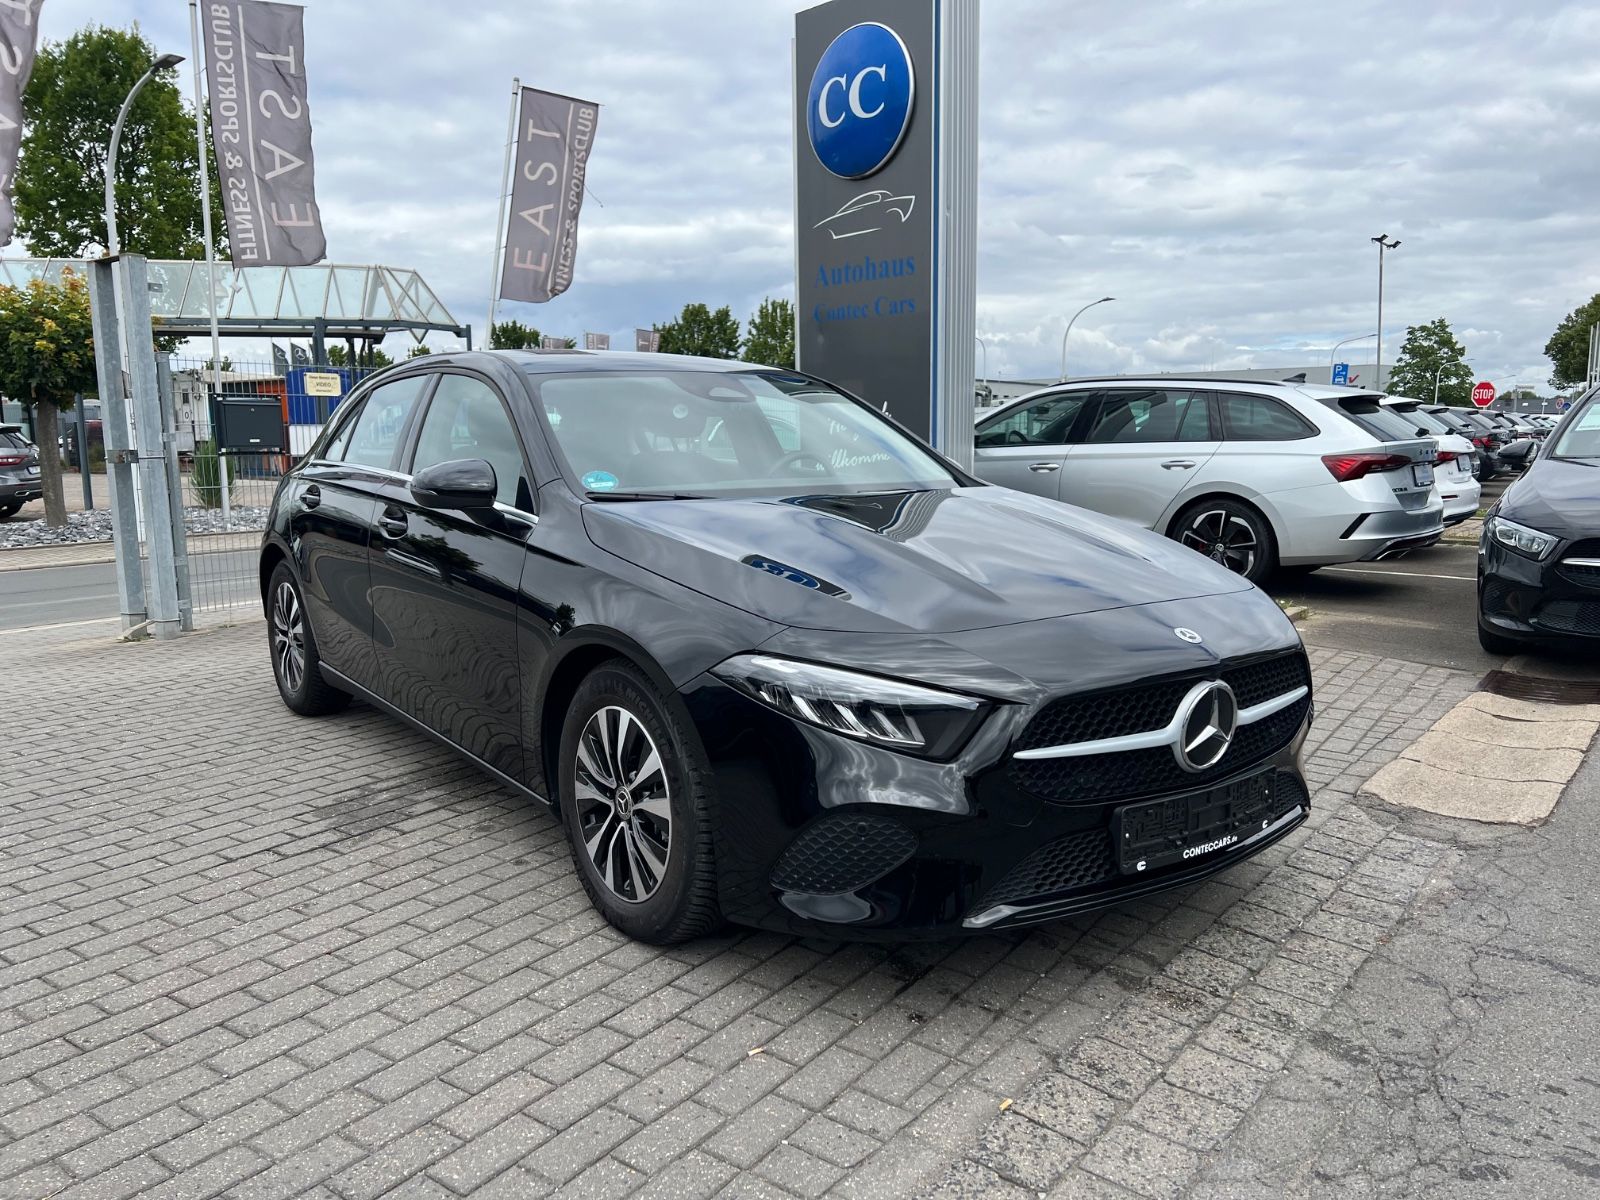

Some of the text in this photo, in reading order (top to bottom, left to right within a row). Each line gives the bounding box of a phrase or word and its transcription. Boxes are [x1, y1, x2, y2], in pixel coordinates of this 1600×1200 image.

[818, 64, 887, 128] CC
[569, 107, 595, 213] SPORTSCLUB
[513, 118, 561, 273] EAST
[565, 219, 576, 232] &
[815, 255, 916, 289] Autohaus
[813, 296, 916, 325] Contec Cars
[1474, 389, 1494, 399] STOP
[1182, 835, 1238, 859] CONTECCARS.de
